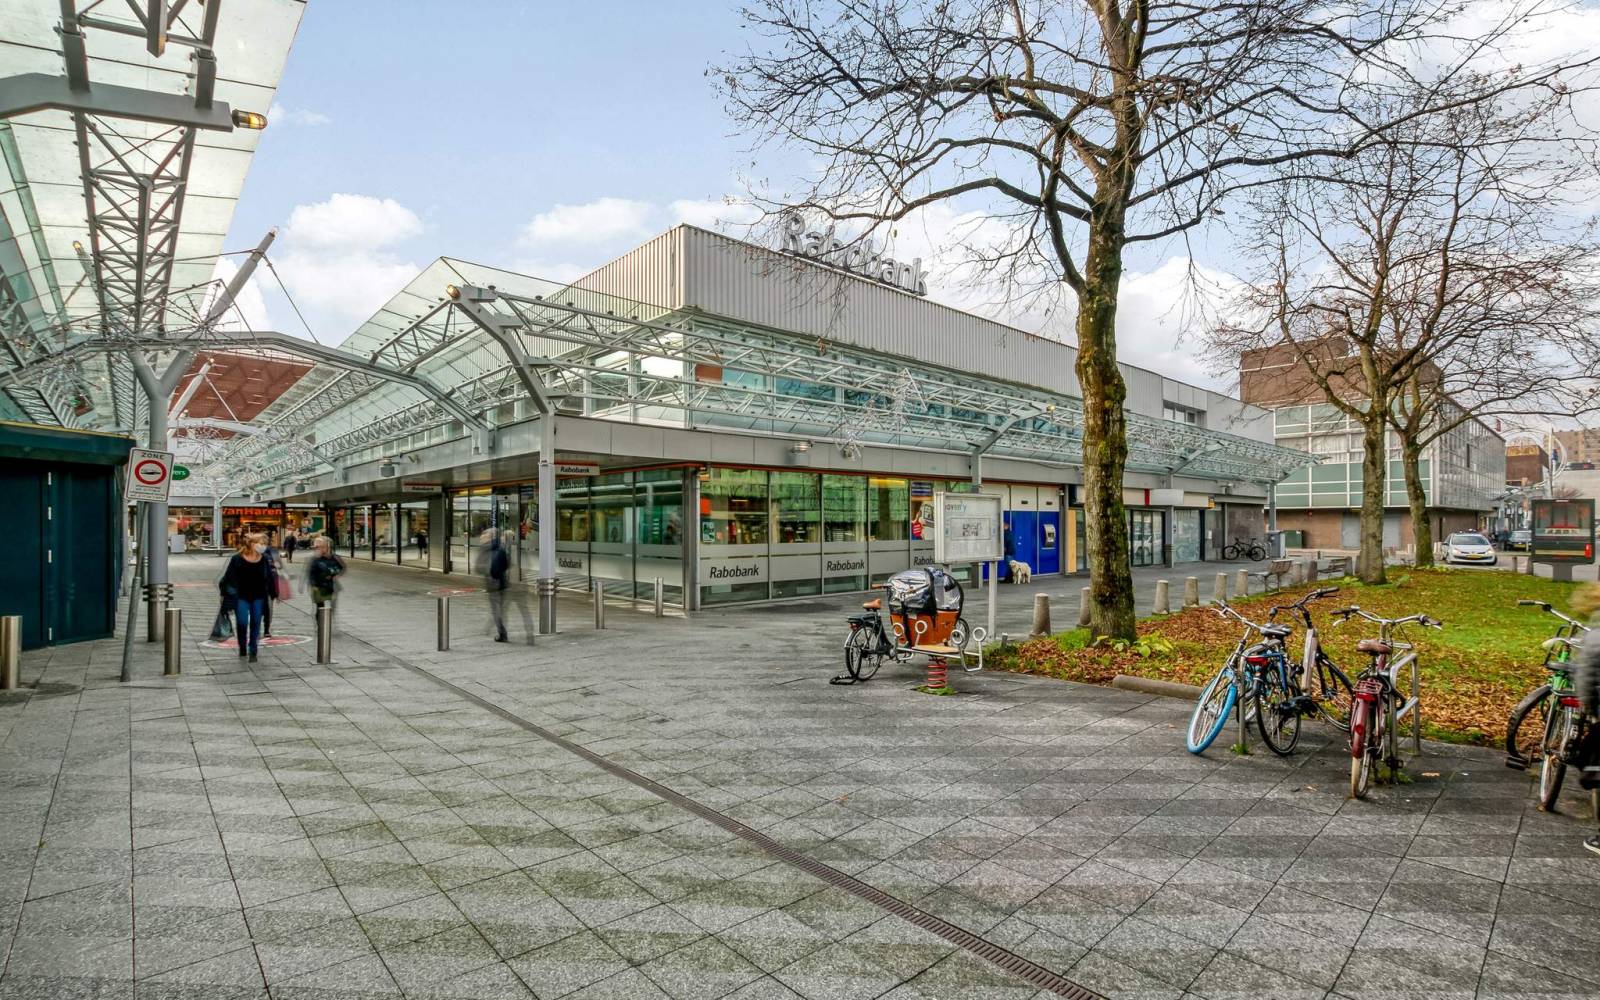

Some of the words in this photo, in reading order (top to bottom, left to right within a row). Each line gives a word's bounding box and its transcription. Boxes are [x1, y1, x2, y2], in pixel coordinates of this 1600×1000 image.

[782, 212, 928, 296] Rabobank
[141, 451, 165, 460] ZONE
[559, 557, 583, 569] Rabobank
[826, 559, 865, 571] Rabobank
[709, 564, 760, 579] Rabobank
